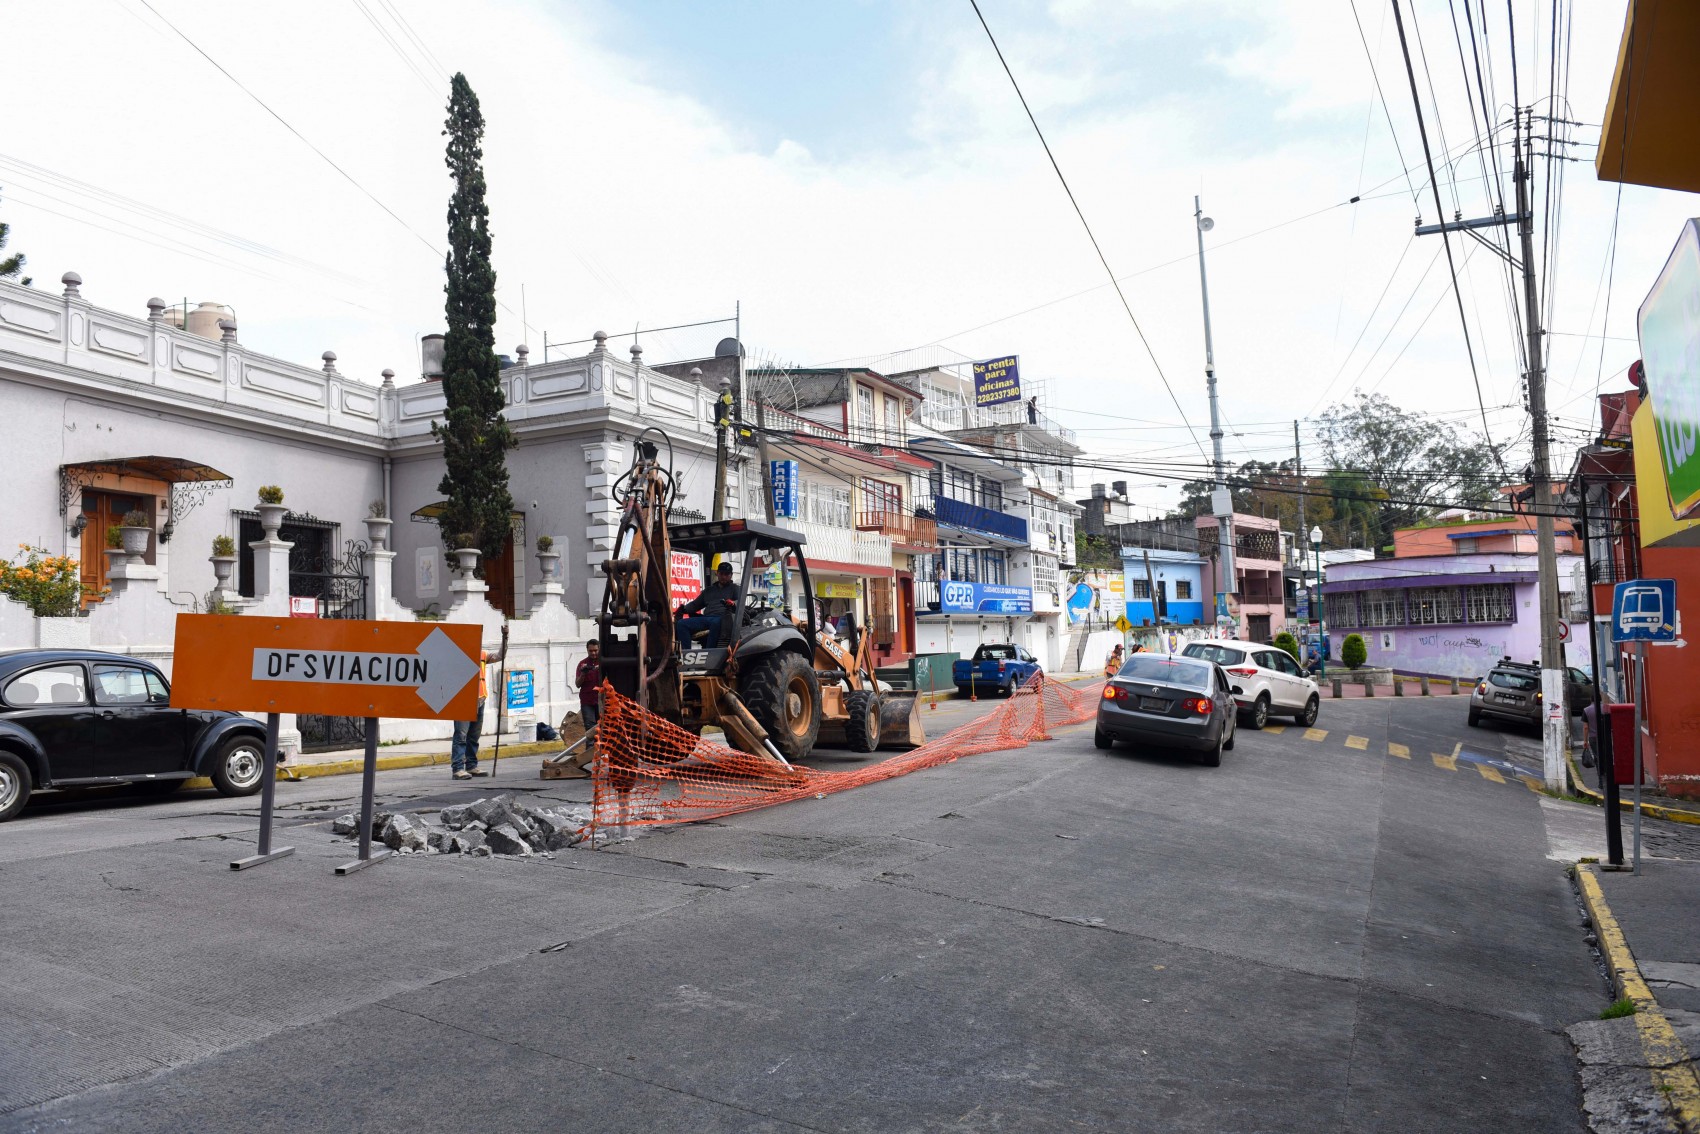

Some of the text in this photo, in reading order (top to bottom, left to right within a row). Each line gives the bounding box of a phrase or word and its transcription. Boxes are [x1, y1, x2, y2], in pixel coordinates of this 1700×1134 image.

[974, 358, 1015, 373] Se renta
[985, 369, 1006, 380] para
[979, 379, 1014, 392] oficinas
[977, 387, 1020, 403] 2282337380
[775, 461, 786, 516] FARMACIA
[671, 554, 693, 566] VENTA
[946, 584, 973, 603] GPR
[824, 638, 843, 660] CASE
